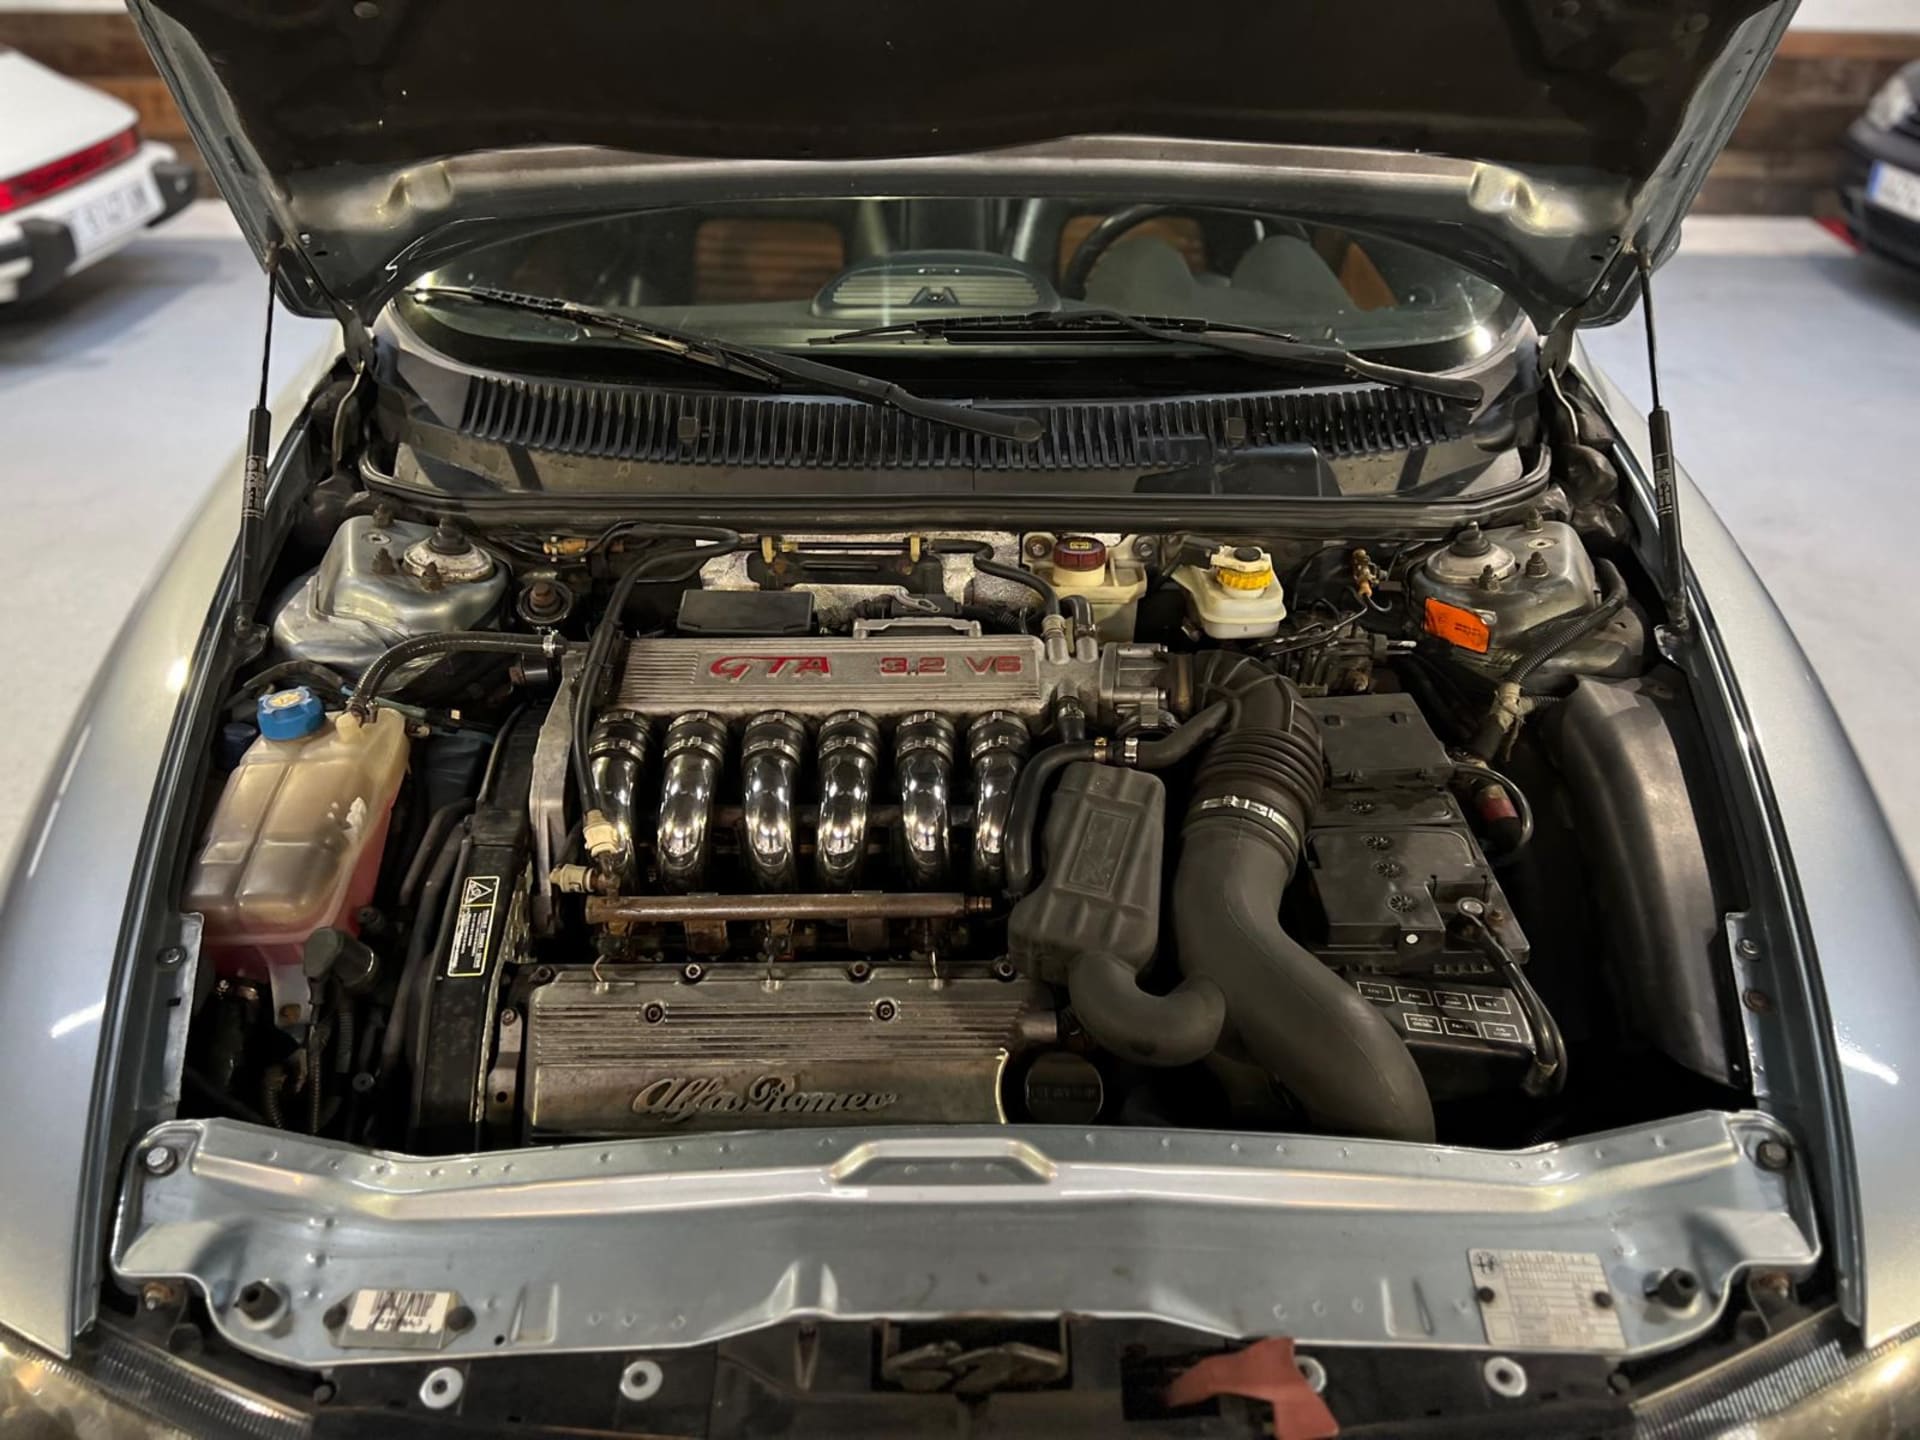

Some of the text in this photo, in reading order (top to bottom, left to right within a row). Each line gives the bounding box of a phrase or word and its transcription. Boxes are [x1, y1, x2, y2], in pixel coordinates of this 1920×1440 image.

[710, 655, 1022, 682] GTA 3.2 V6
[632, 1074, 897, 1123] Alfa Romeo
